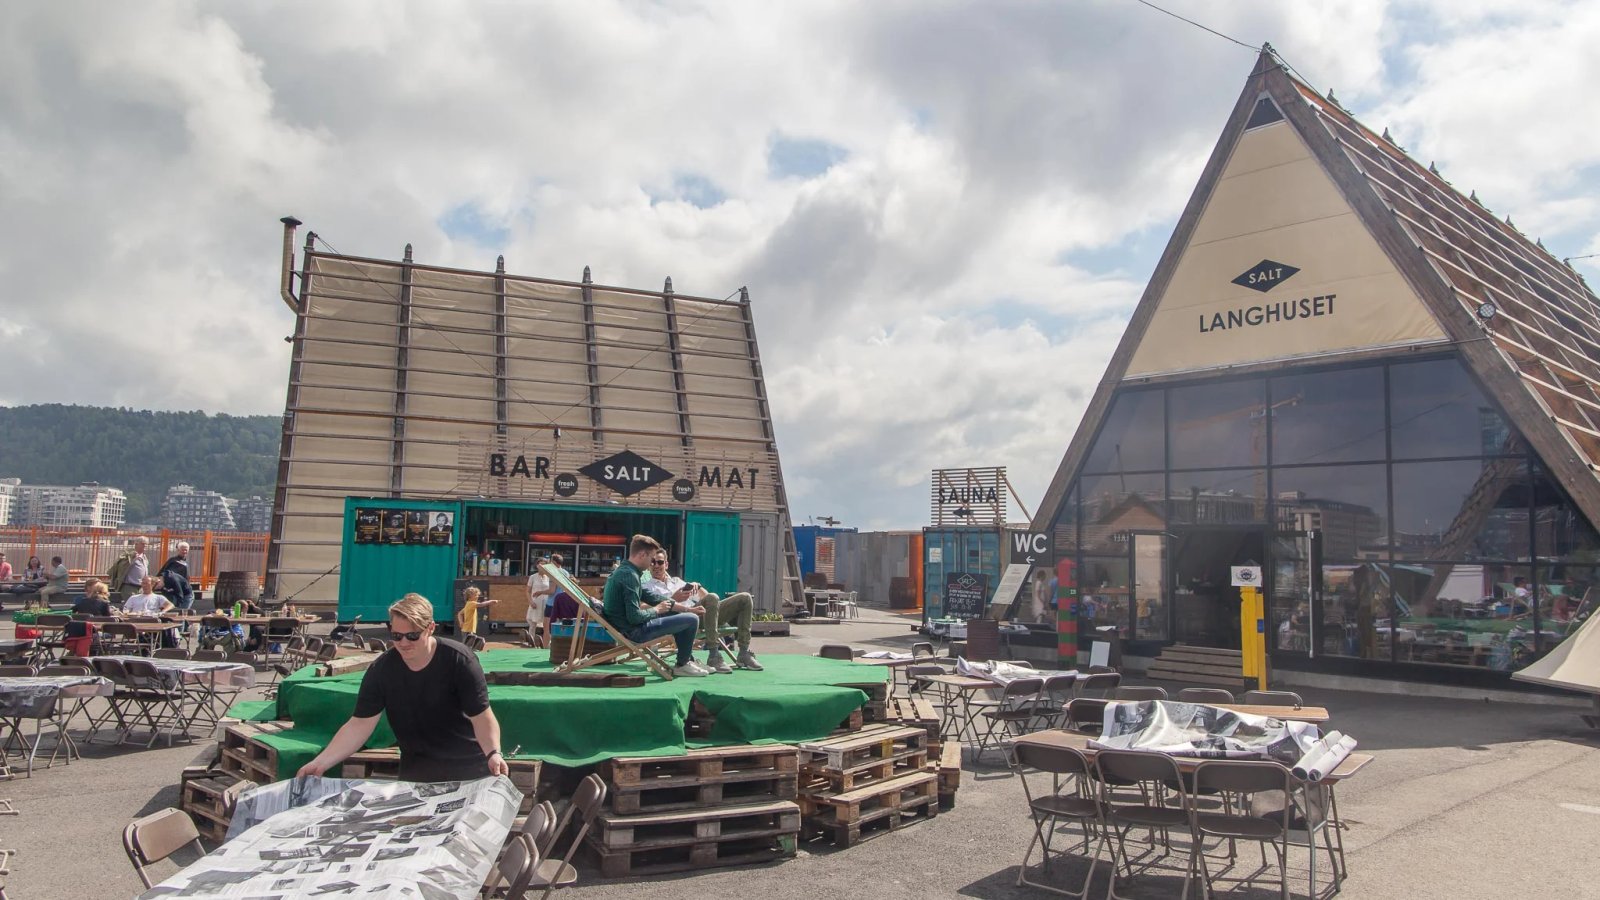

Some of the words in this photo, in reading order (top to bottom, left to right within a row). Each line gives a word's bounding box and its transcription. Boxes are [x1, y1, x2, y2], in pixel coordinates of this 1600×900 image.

[1248, 268, 1282, 284] SALT
[1200, 294, 1336, 333] LANGHUSET
[490, 453, 550, 479] BAR
[603, 464, 651, 482] SALT
[699, 465, 759, 490] MAT
[938, 486, 998, 504] SAUNA
[1014, 533, 1047, 553] WC
